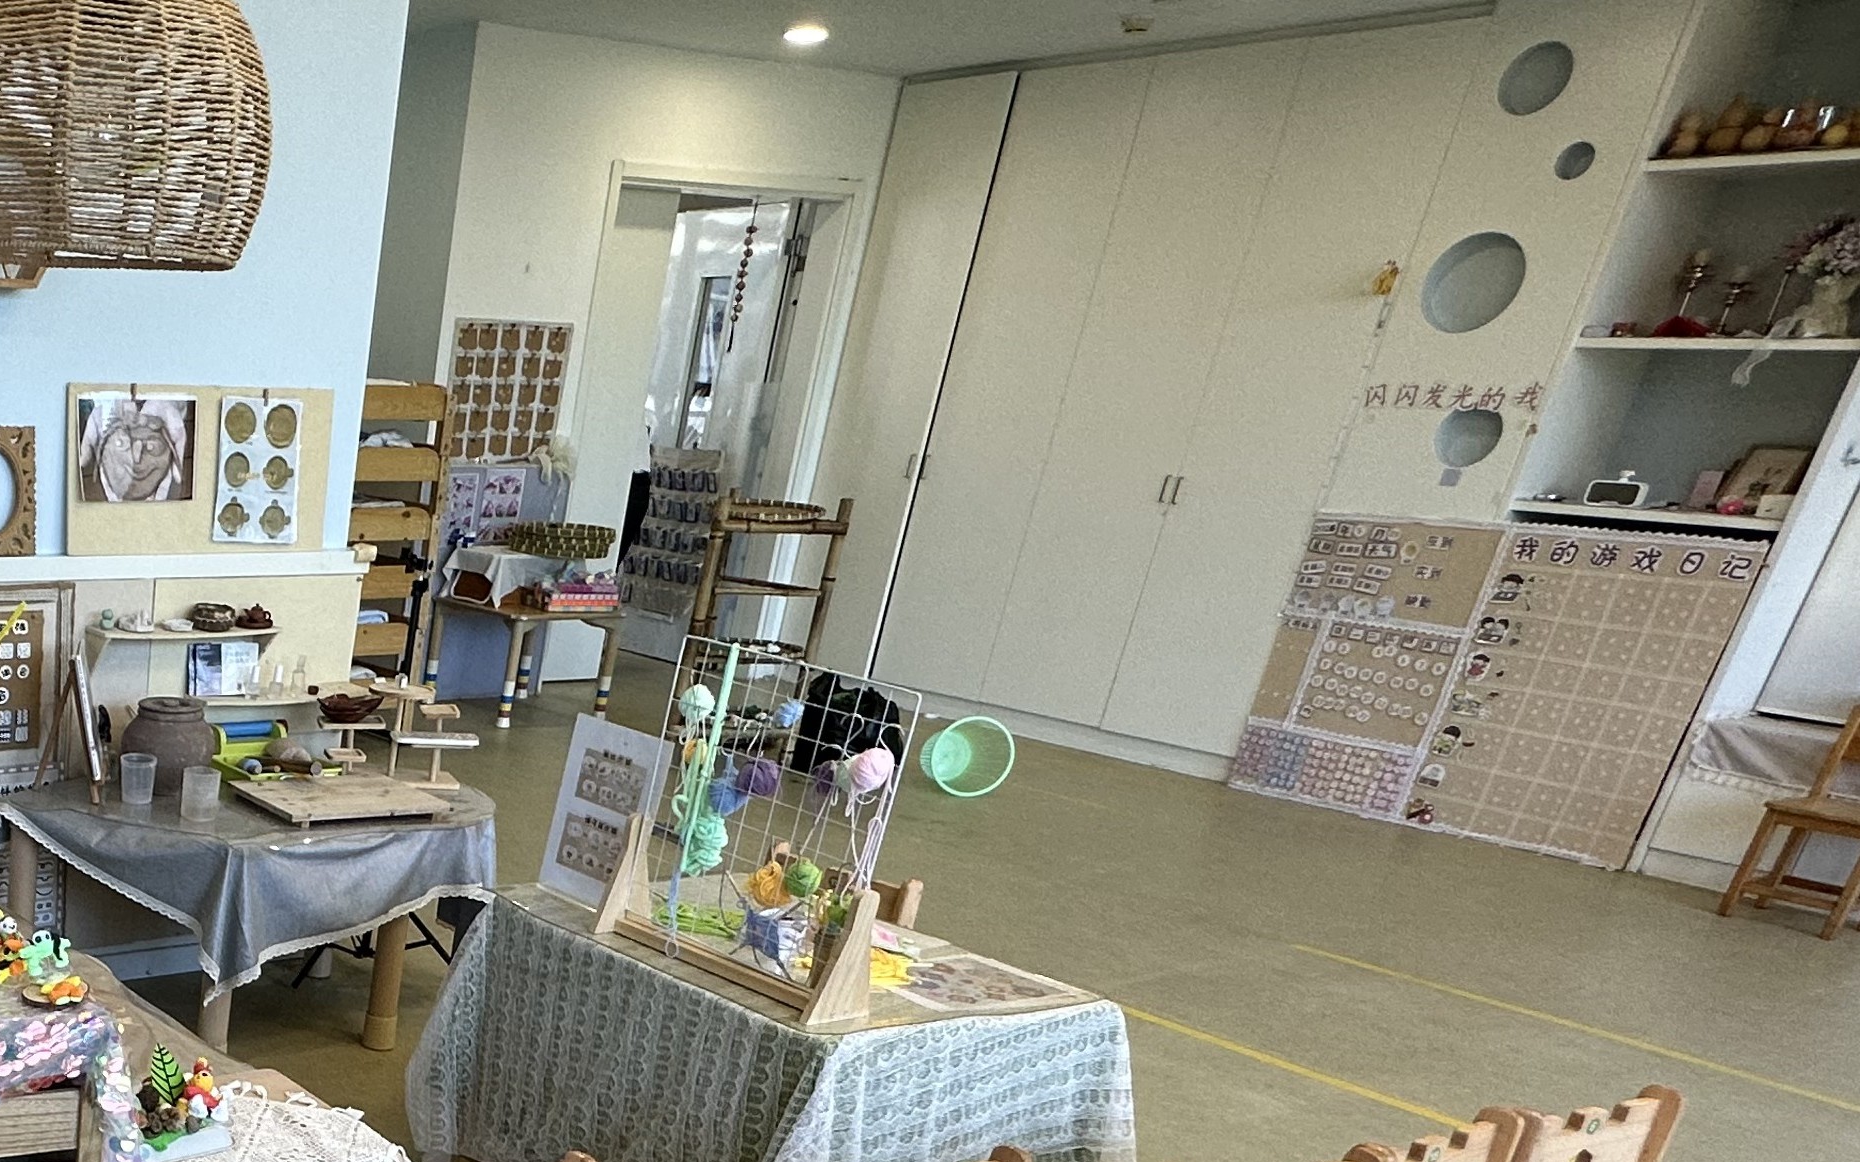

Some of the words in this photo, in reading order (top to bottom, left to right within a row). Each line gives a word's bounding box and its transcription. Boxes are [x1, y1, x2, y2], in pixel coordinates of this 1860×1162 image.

[1364, 382, 1543, 412] 闪闪发光的我
[1514, 536, 1753, 580] 我的游戏日记
